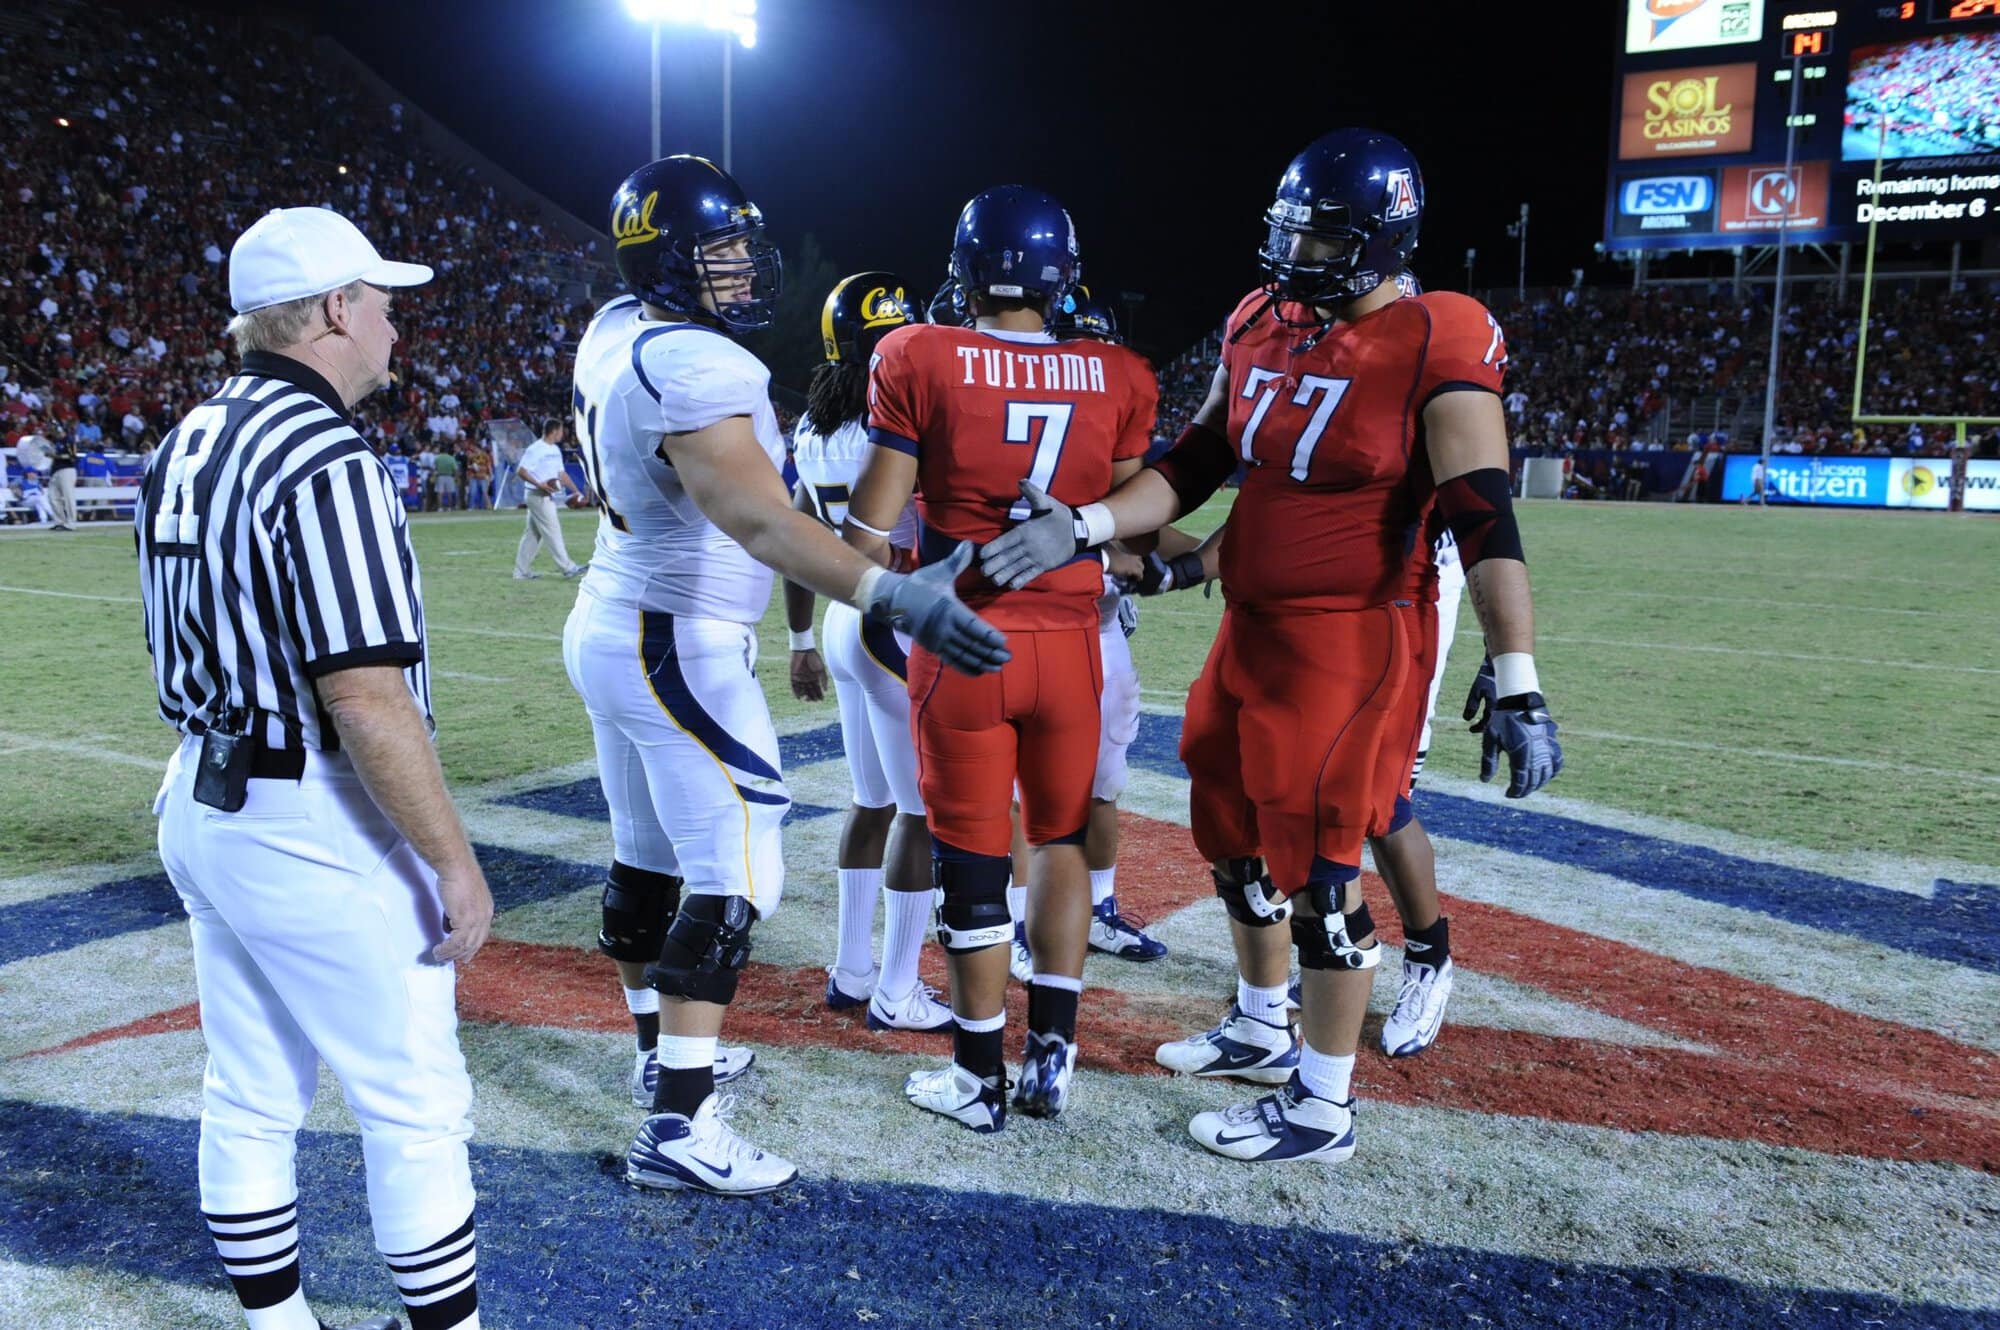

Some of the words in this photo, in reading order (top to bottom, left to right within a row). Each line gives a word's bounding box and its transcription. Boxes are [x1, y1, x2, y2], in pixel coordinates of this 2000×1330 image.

[1645, 76, 1731, 120] SOL
[1643, 116, 1731, 139] CASINOS
[1385, 168, 1419, 222] A
[1634, 180, 1698, 209] FSN
[1857, 176, 1949, 195] Remaining
[611, 191, 660, 248] Cal
[1857, 200, 1967, 223] December
[1969, 198, 1986, 217] 6
[861, 287, 905, 330] Cal
[957, 347, 1105, 392] TUITAMA
[1241, 366, 1353, 483] 77
[155, 405, 228, 544] R
[1004, 401, 1075, 520] 7
[1810, 461, 1866, 476] Tucson
